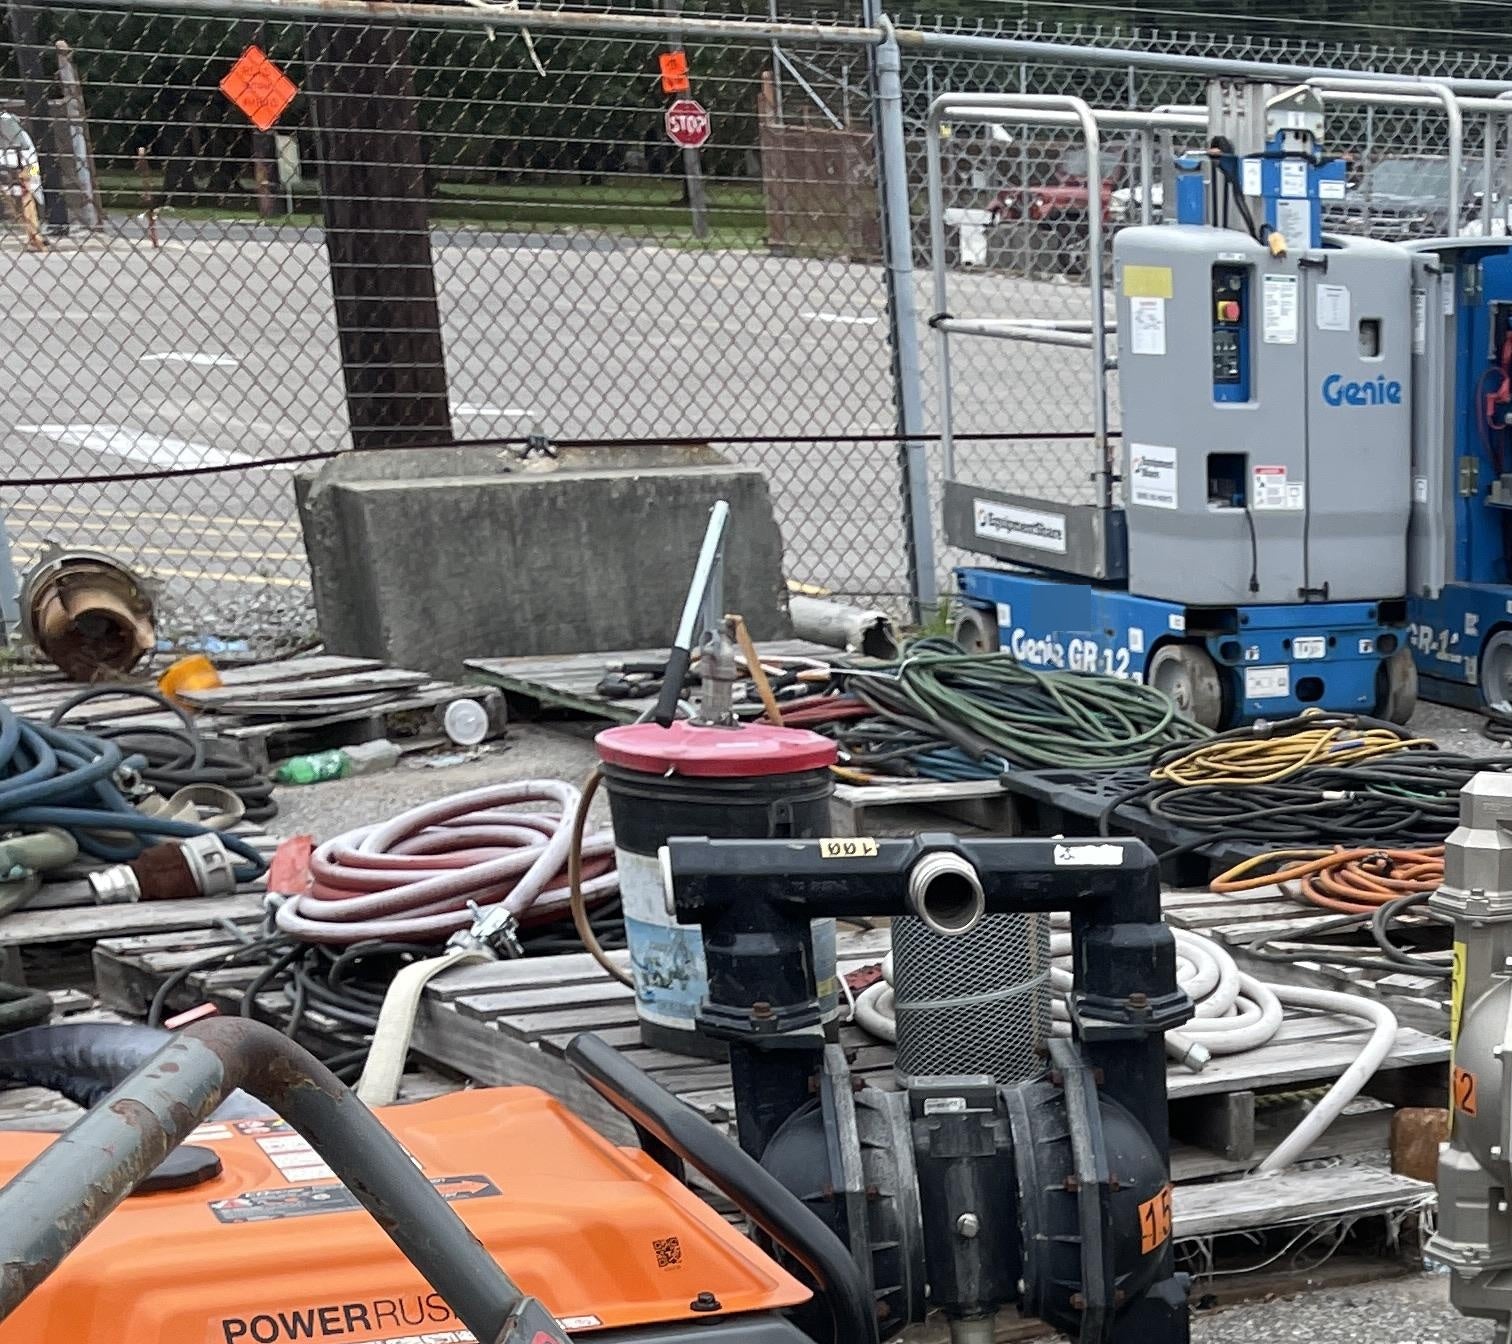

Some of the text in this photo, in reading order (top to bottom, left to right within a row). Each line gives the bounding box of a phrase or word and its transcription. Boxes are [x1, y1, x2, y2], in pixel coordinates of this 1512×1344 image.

[669, 115, 708, 133] STOP
[1322, 374, 1402, 407] Genie
[1011, 628, 1065, 669] Genie
